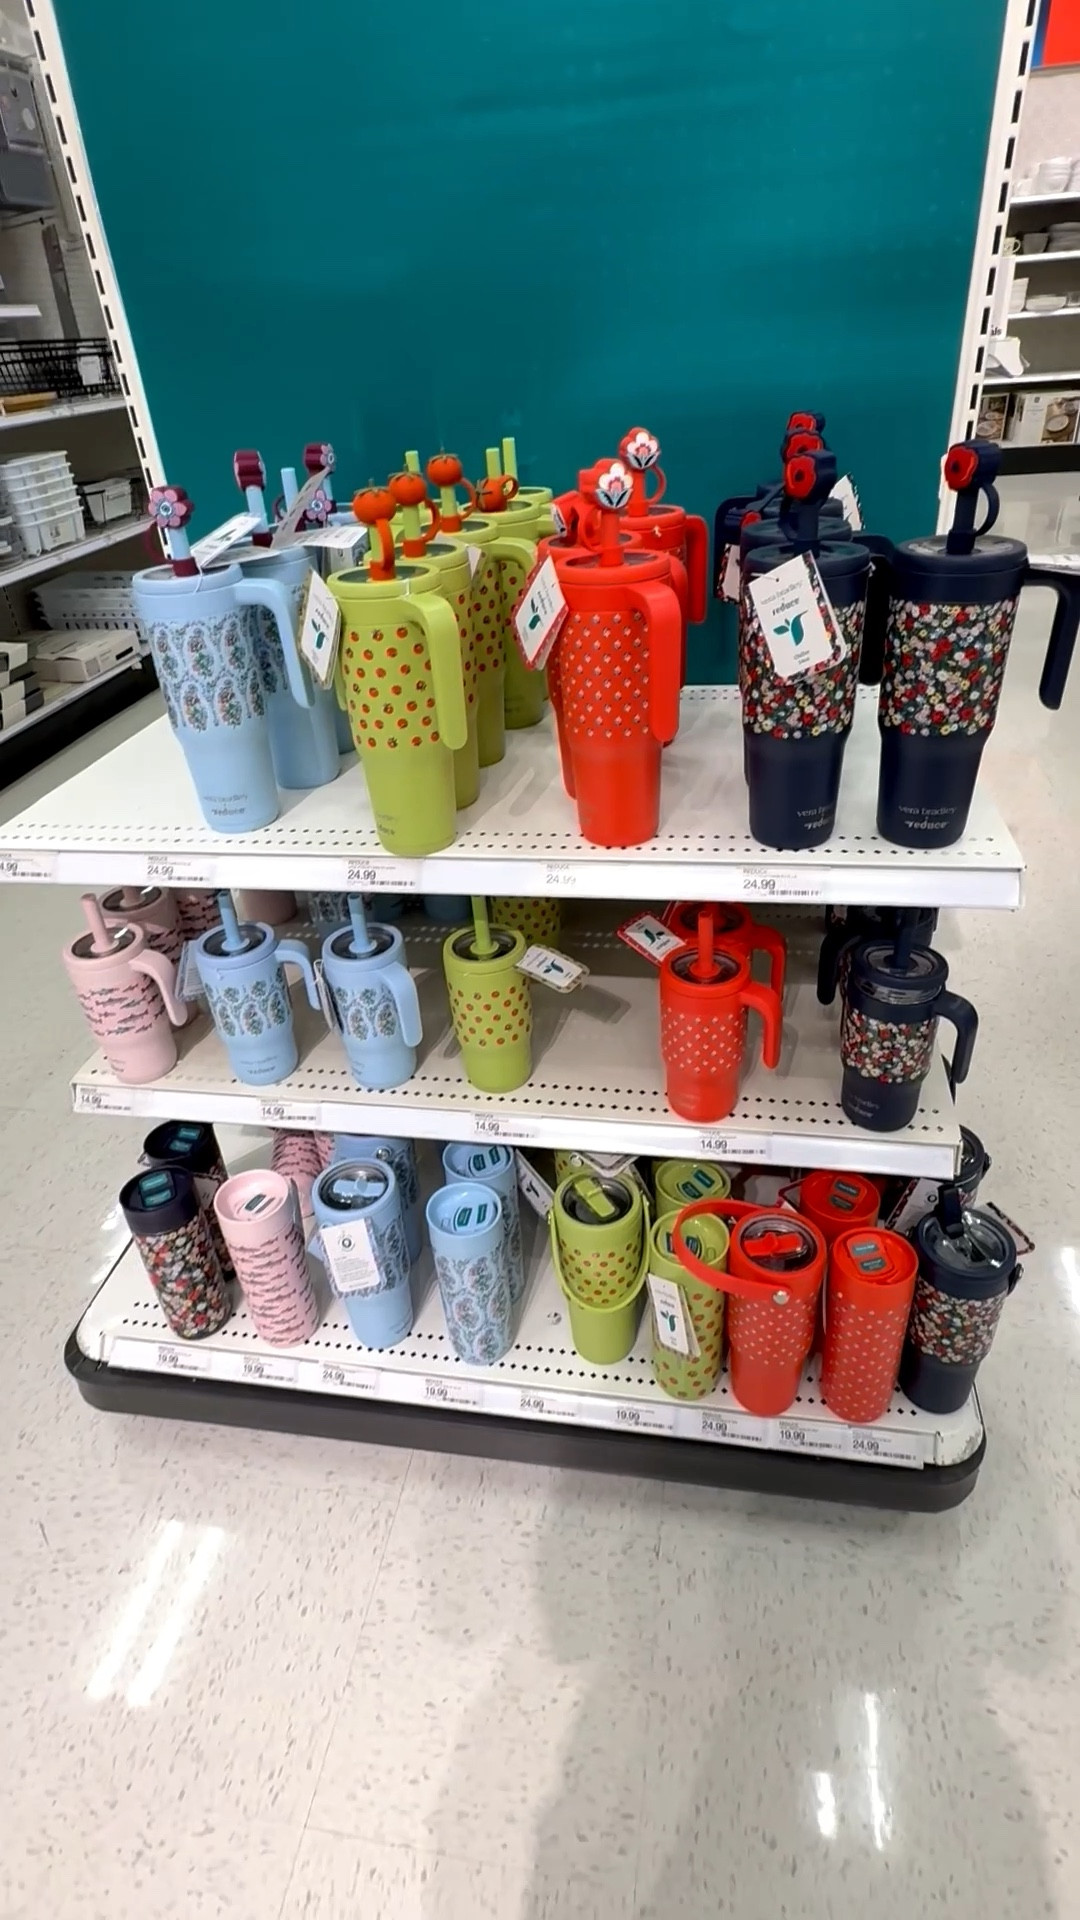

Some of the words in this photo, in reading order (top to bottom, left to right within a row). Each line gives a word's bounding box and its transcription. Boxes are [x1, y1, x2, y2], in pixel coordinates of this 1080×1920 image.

[772, 597, 800, 616] reduce
[899, 805, 919, 815] vera
[920, 805, 957, 816] bradley
[904, 819, 950, 831] reduce
[147, 865, 174, 876] 24.99
[347, 869, 377, 881] 24.99
[742, 878, 776, 890] 24.99
[81, 1094, 102, 1105] 14.99
[262, 1106, 285, 1117] 14.99
[475, 1121, 500, 1132] 14.99
[701, 1139, 728, 1150] 14.99
[158, 1353, 179, 1364] 19.99
[244, 1363, 265, 1375] 19.99
[322, 1369, 345, 1381] 24.99
[425, 1386, 448, 1397] 19.99
[520, 1398, 545, 1409] 24.99
[616, 1409, 641, 1421] 19.99
[702, 1420, 728, 1432] 24.99
[780, 1430, 806, 1441] 19.99
[852, 1440, 880, 1451] 24.99
